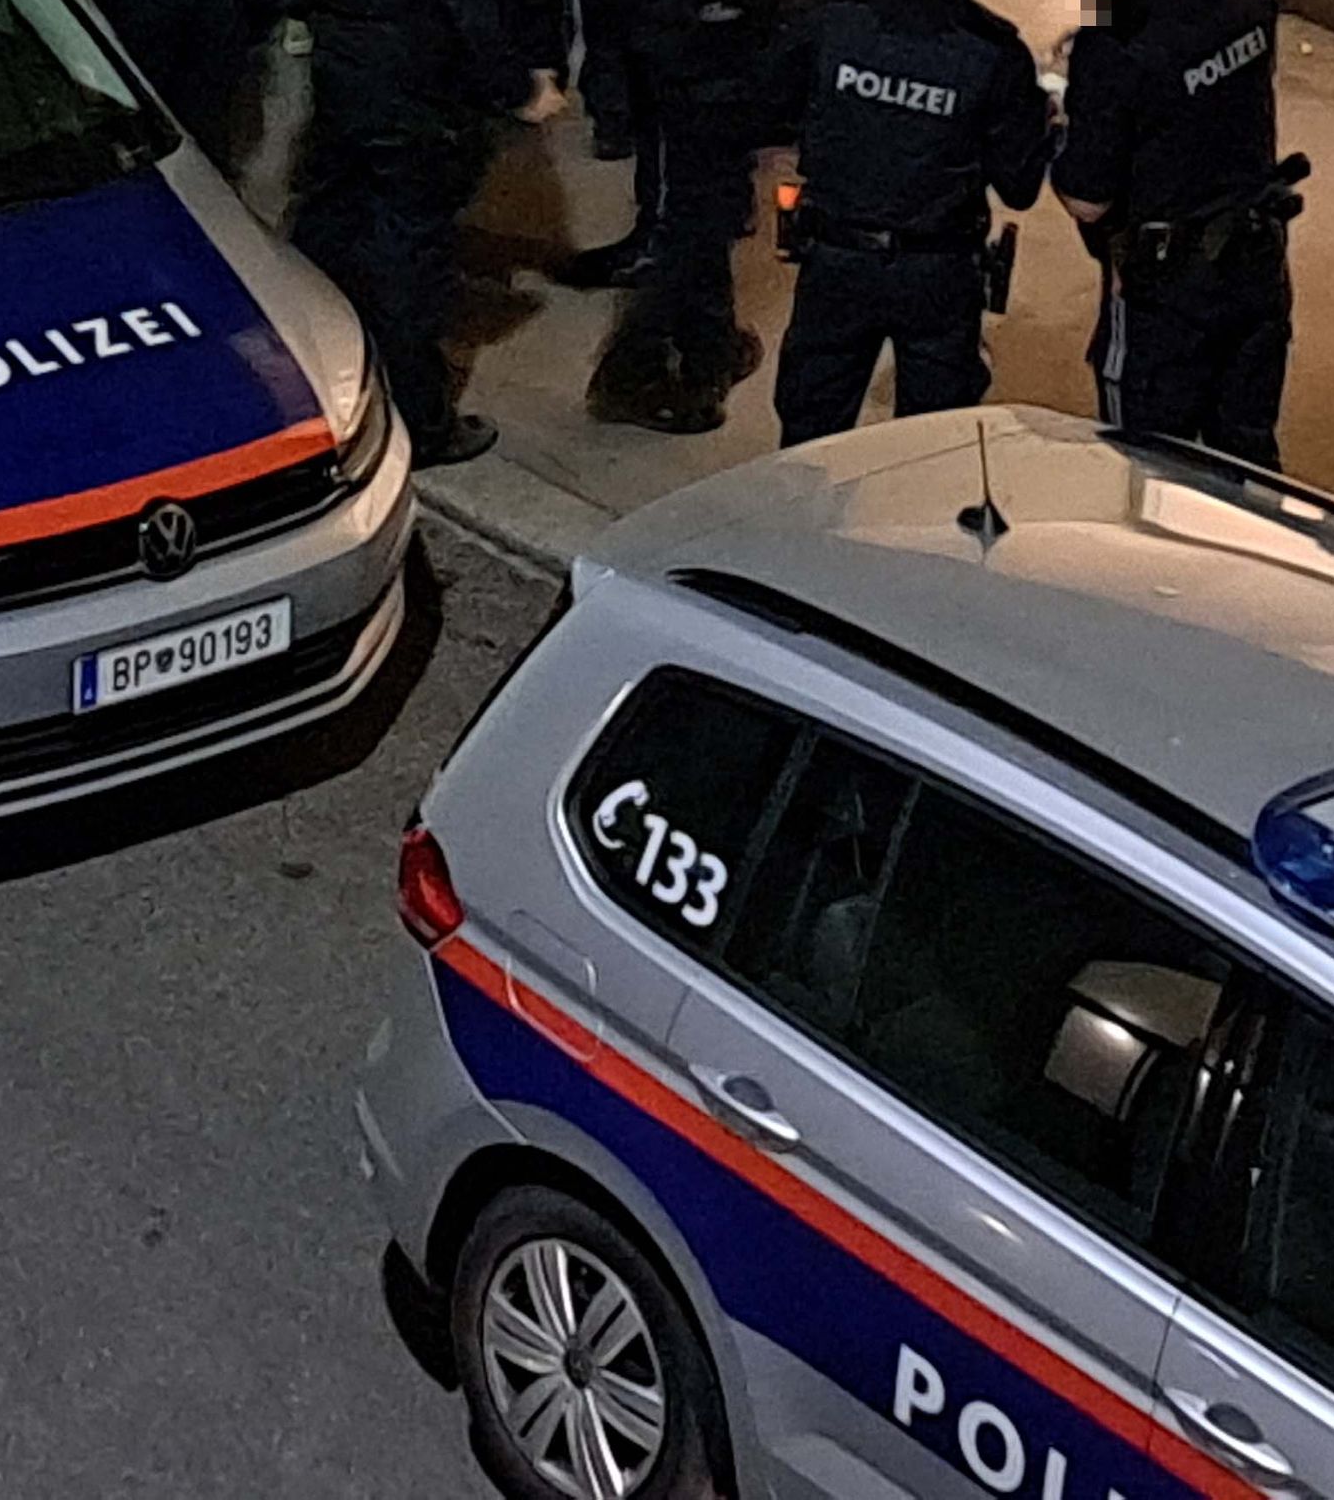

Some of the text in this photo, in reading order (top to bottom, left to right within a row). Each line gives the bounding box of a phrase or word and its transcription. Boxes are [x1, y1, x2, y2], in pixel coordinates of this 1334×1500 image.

[835, 63, 957, 116] POLIZEI
[1183, 25, 1267, 95] POLIZEI
[113, 613, 272, 692] BP 90193
[636, 812, 729, 928] 133
[893, 1342, 1127, 1500] PO
